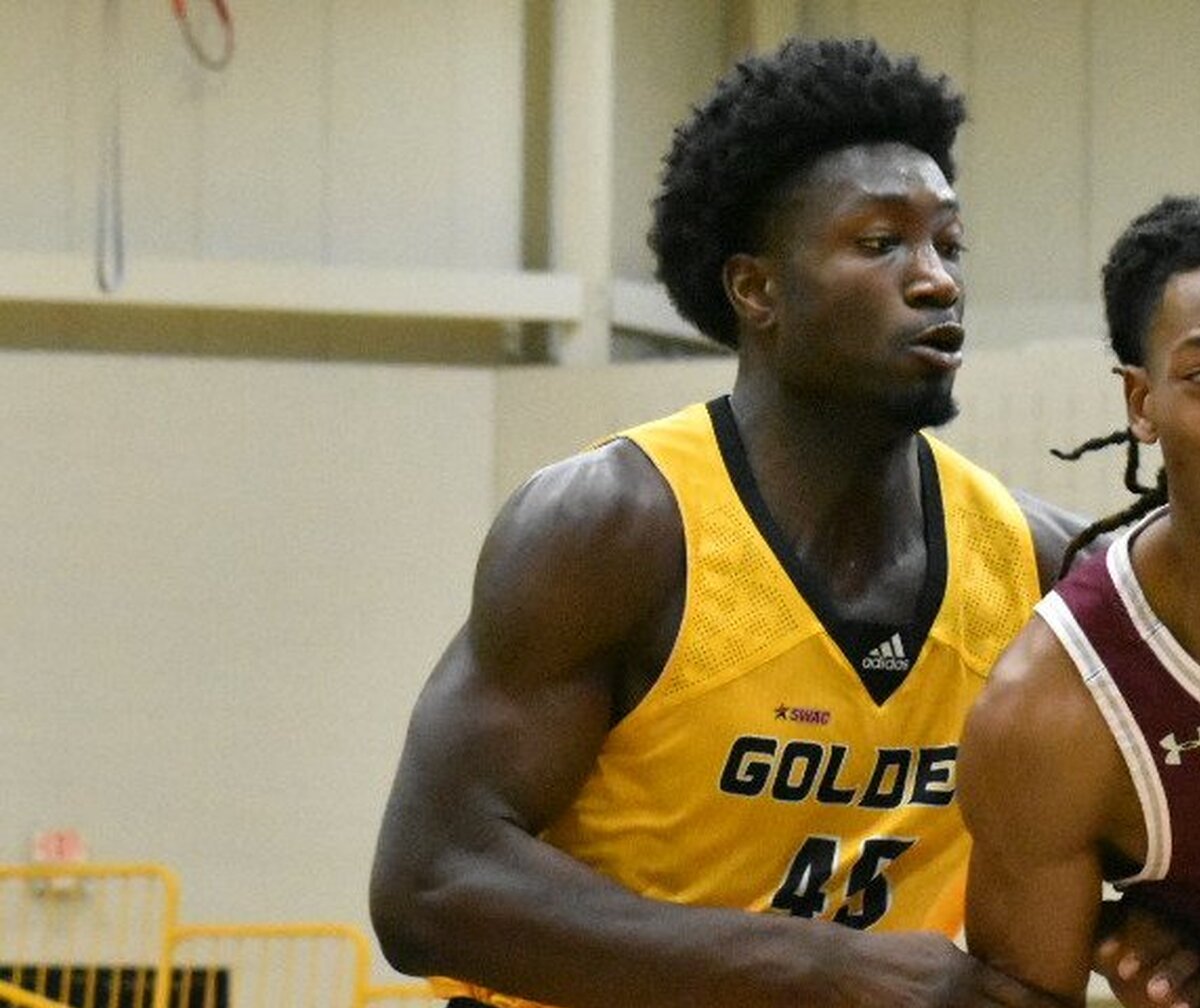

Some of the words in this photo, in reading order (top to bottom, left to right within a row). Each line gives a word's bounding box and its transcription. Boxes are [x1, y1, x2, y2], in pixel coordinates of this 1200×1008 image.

[862, 656, 909, 671] adidas
[789, 707, 831, 726] SWAC
[719, 734, 959, 809] GOLDE
[769, 834, 917, 931] 45
